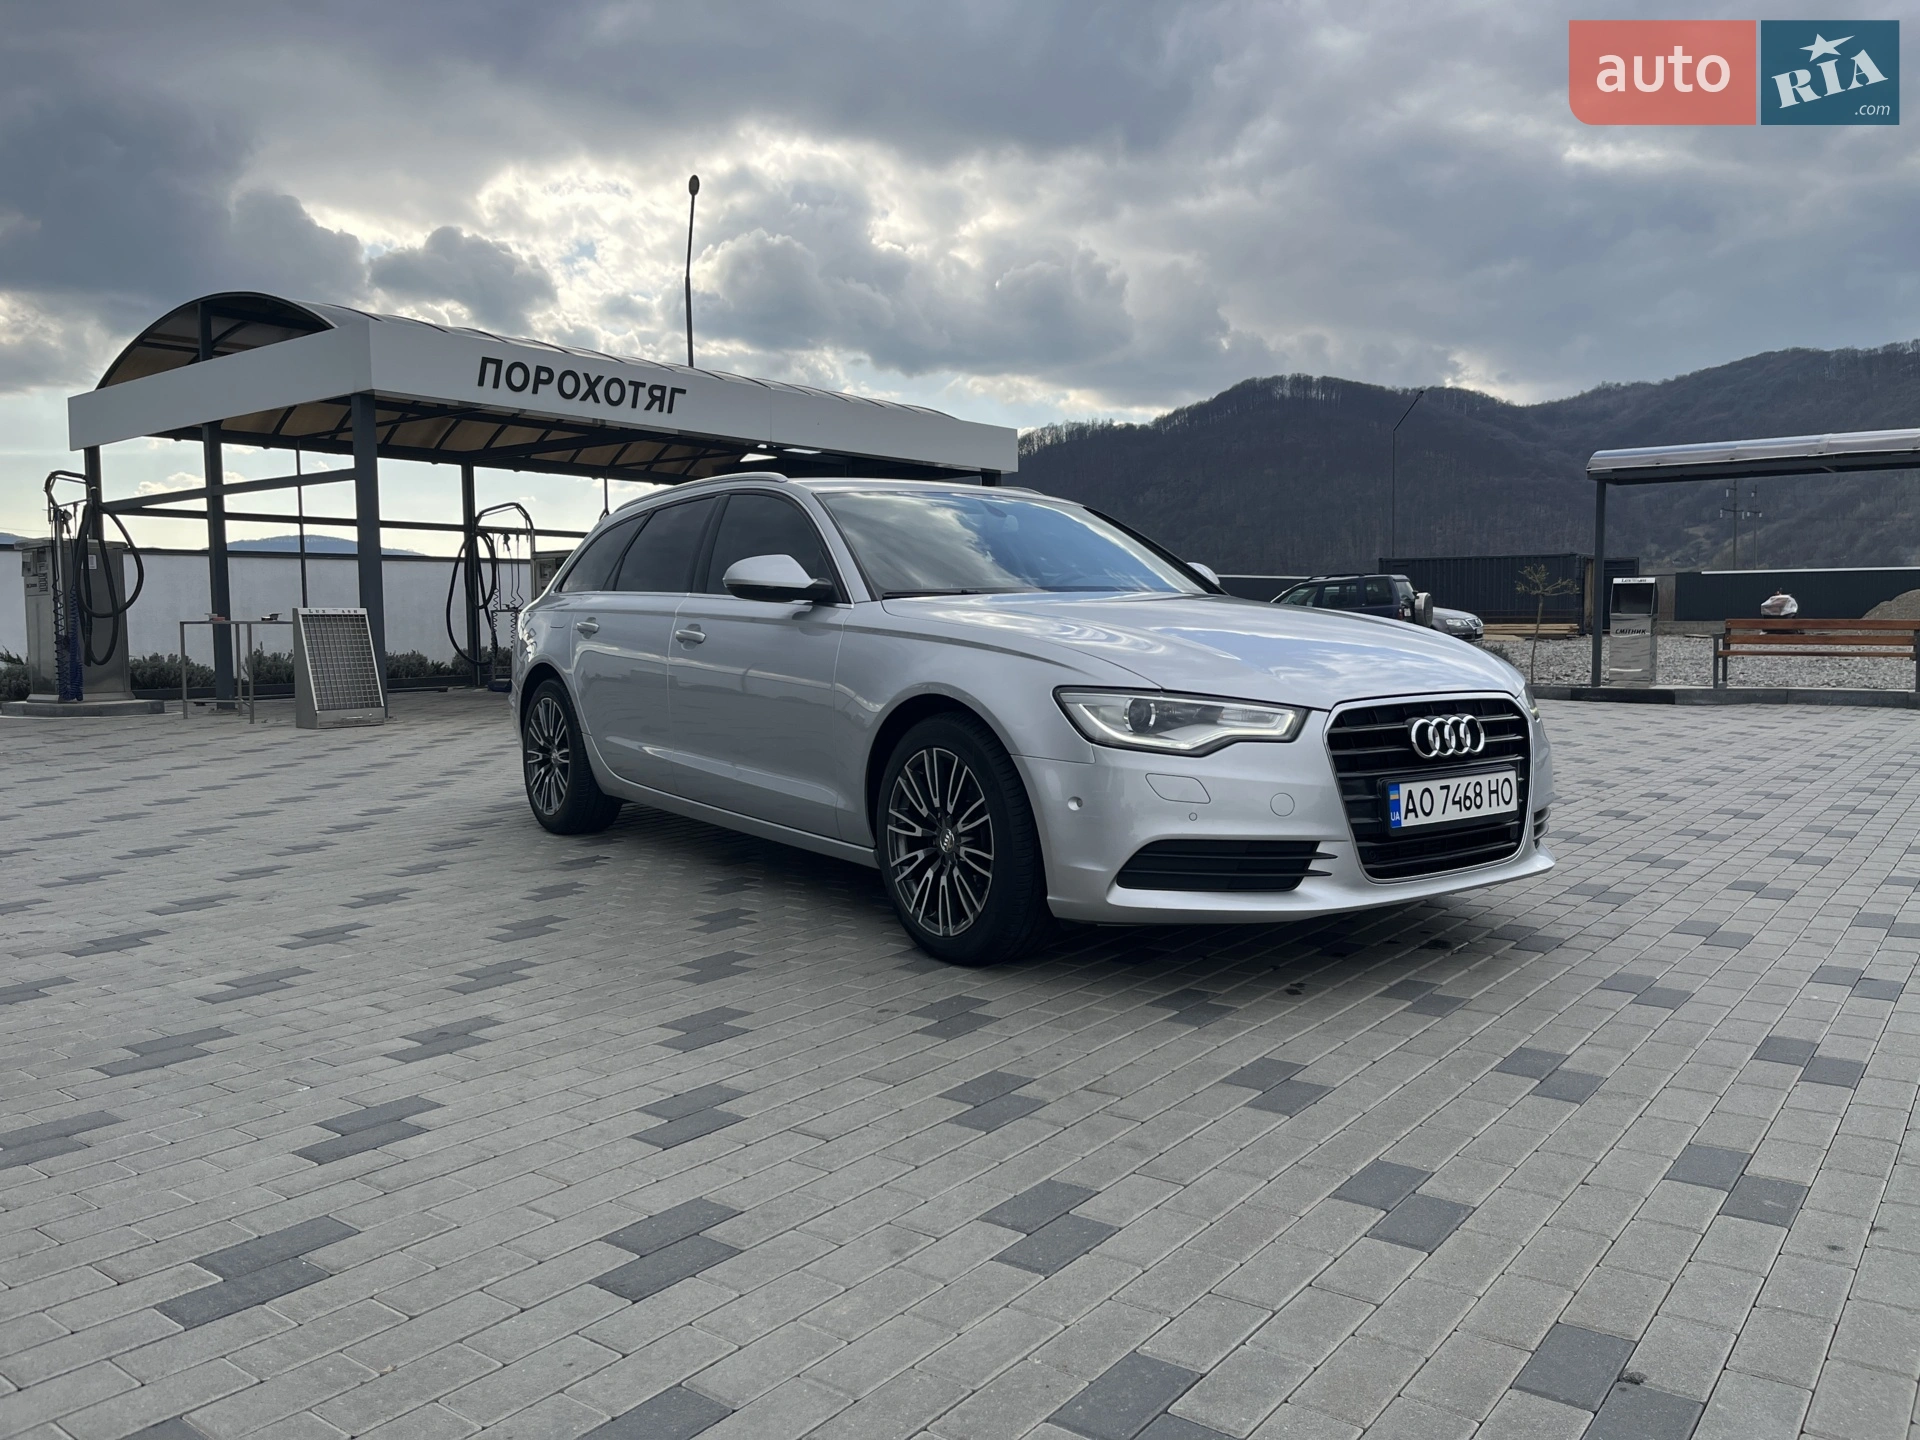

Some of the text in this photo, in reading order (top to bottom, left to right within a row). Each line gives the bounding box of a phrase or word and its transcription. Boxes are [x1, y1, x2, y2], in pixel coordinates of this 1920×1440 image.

[477, 356, 687, 414] ПОРОХОТЯГ
[1390, 811, 1401, 821] UA
[1403, 777, 1513, 820] AO 7468 HO
